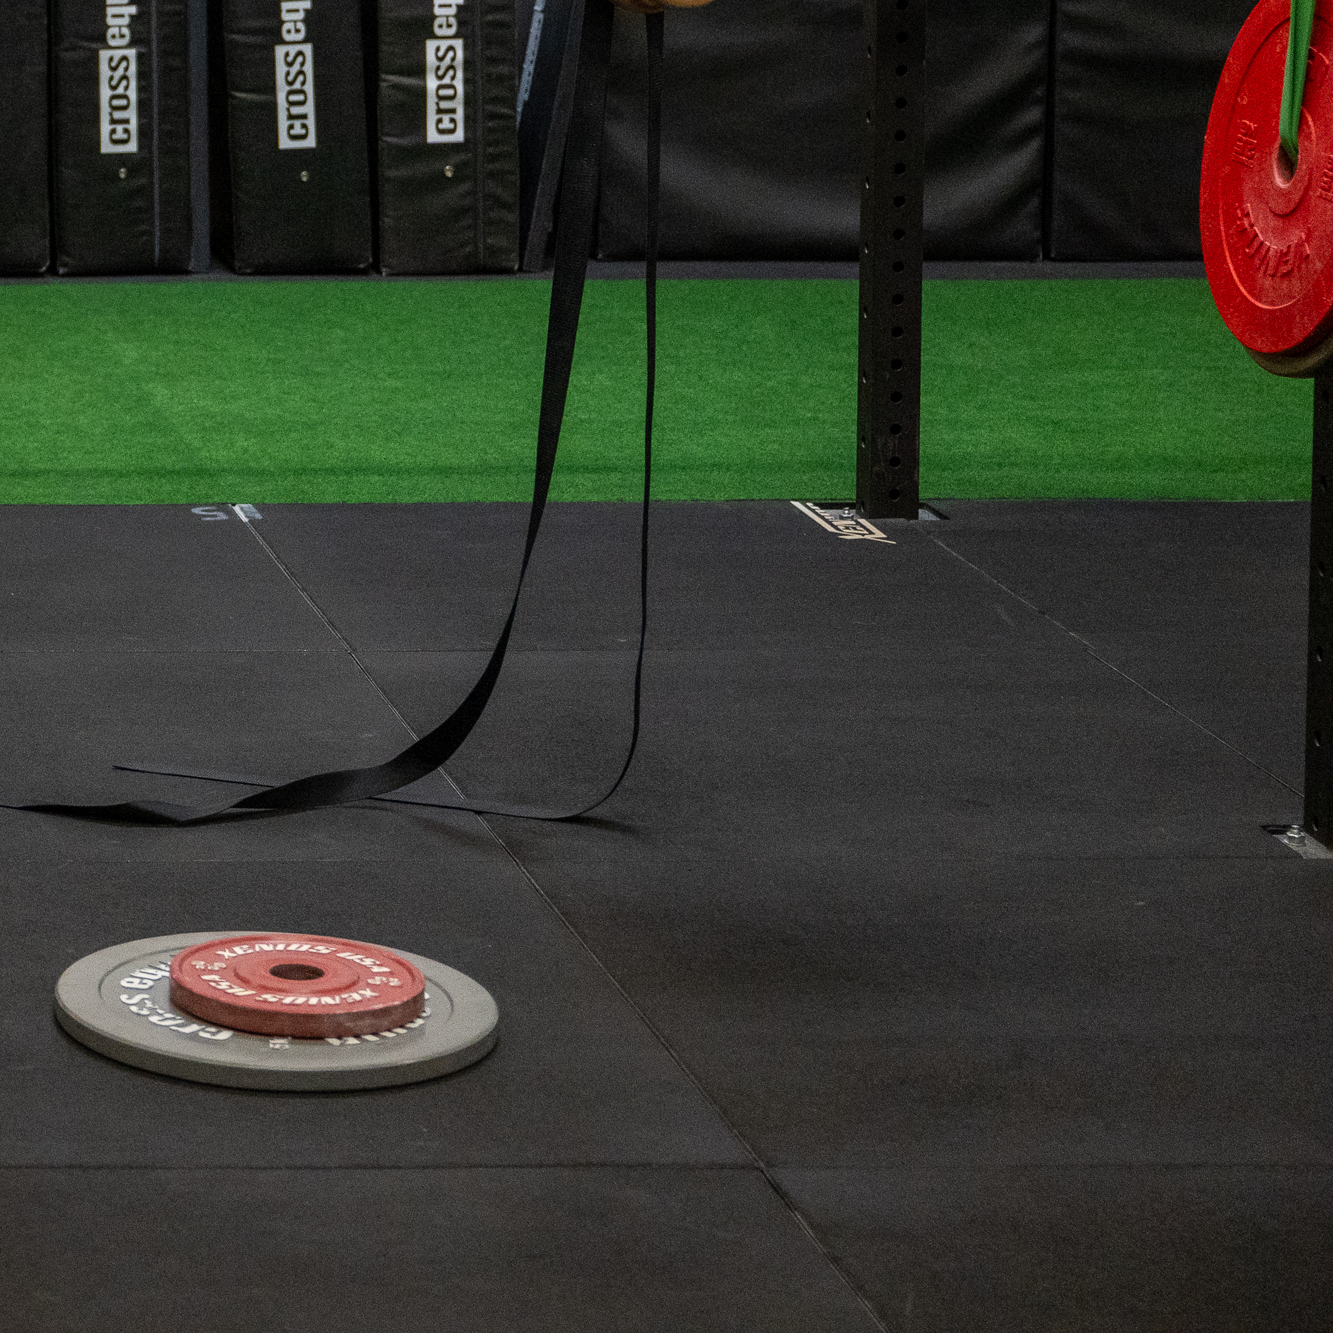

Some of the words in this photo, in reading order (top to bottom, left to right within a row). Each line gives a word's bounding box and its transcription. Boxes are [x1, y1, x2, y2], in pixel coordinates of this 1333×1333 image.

[107, 55, 132, 146] cross
[282, 50, 309, 142] cross
[434, 44, 458, 136] cross
[200, 973, 257, 996] USA
[216, 943, 337, 960] XENIUS
[336, 952, 391, 973] USA
[256, 987, 380, 1005] XENIUS
